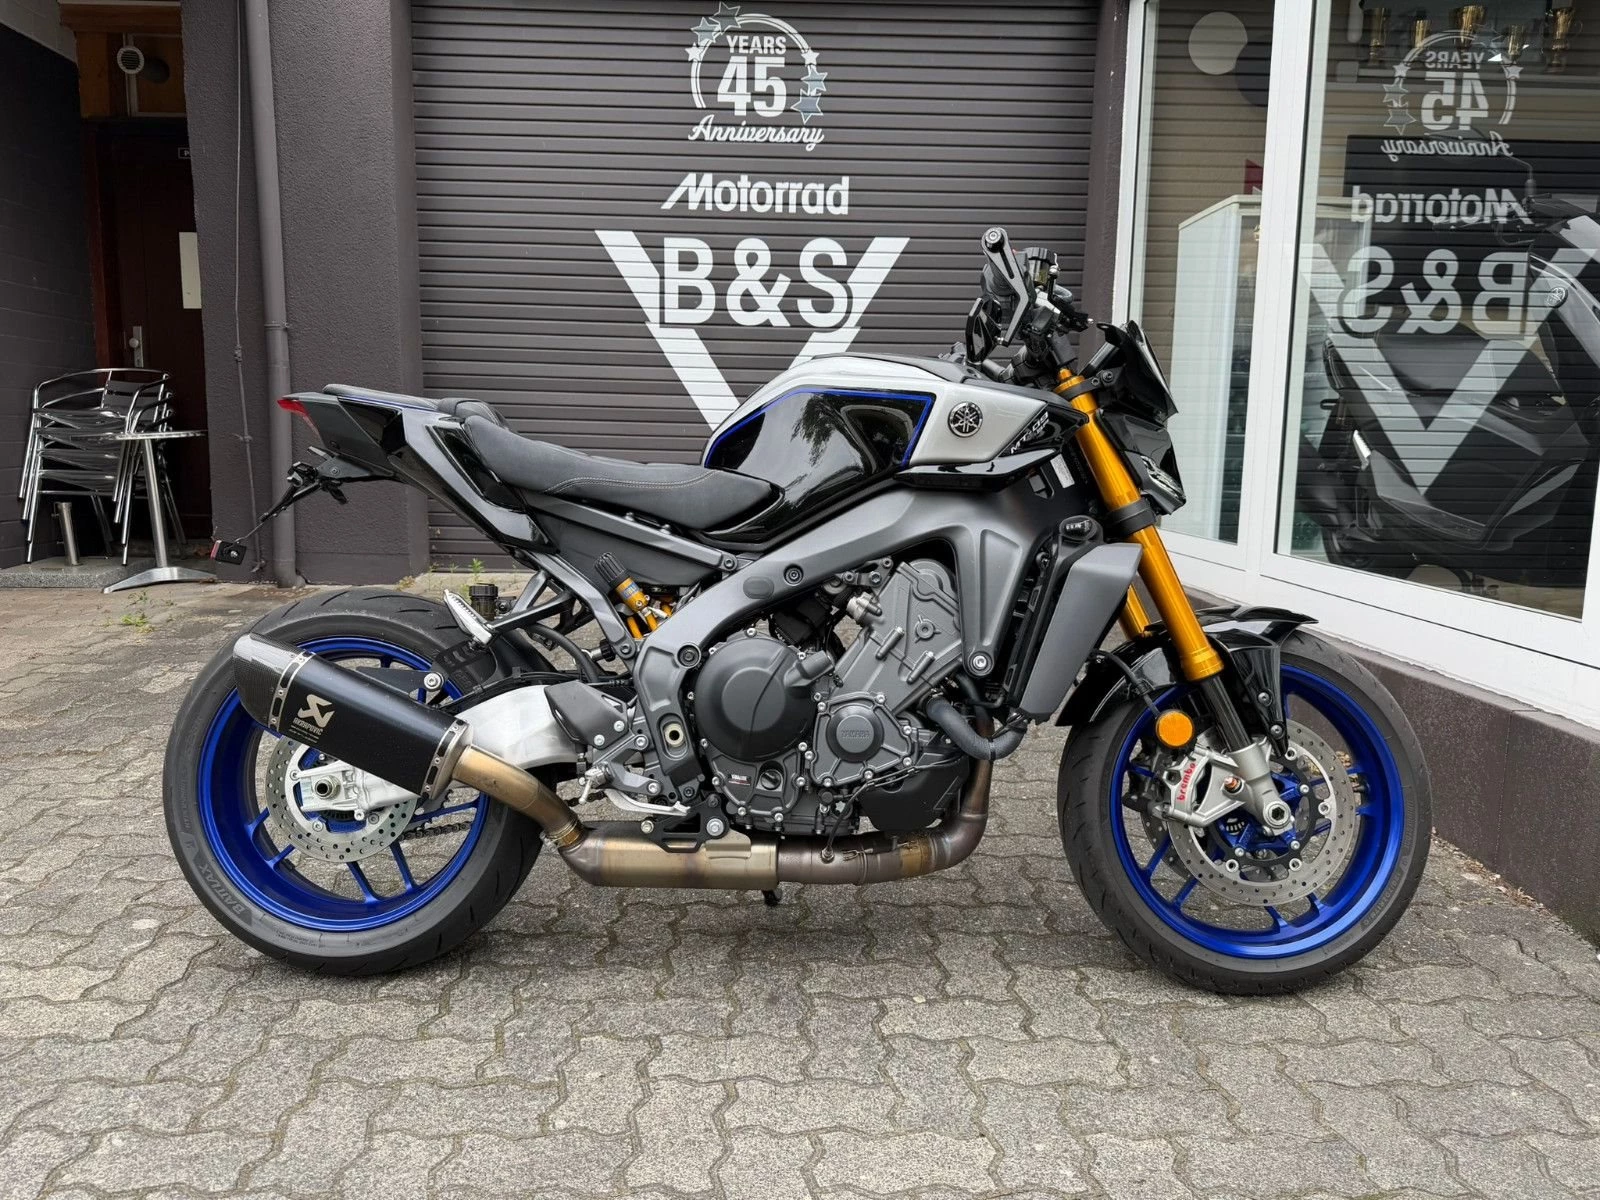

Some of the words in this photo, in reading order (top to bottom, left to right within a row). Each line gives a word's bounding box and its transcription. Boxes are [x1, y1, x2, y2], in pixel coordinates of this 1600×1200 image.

[726, 35, 787, 55] YEARS
[717, 55, 787, 118] 45
[688, 114, 825, 151] Anniversary
[660, 172, 850, 216] Motorrad
[663, 237, 849, 328] B&S
[1176, 762, 1197, 801] brembo
